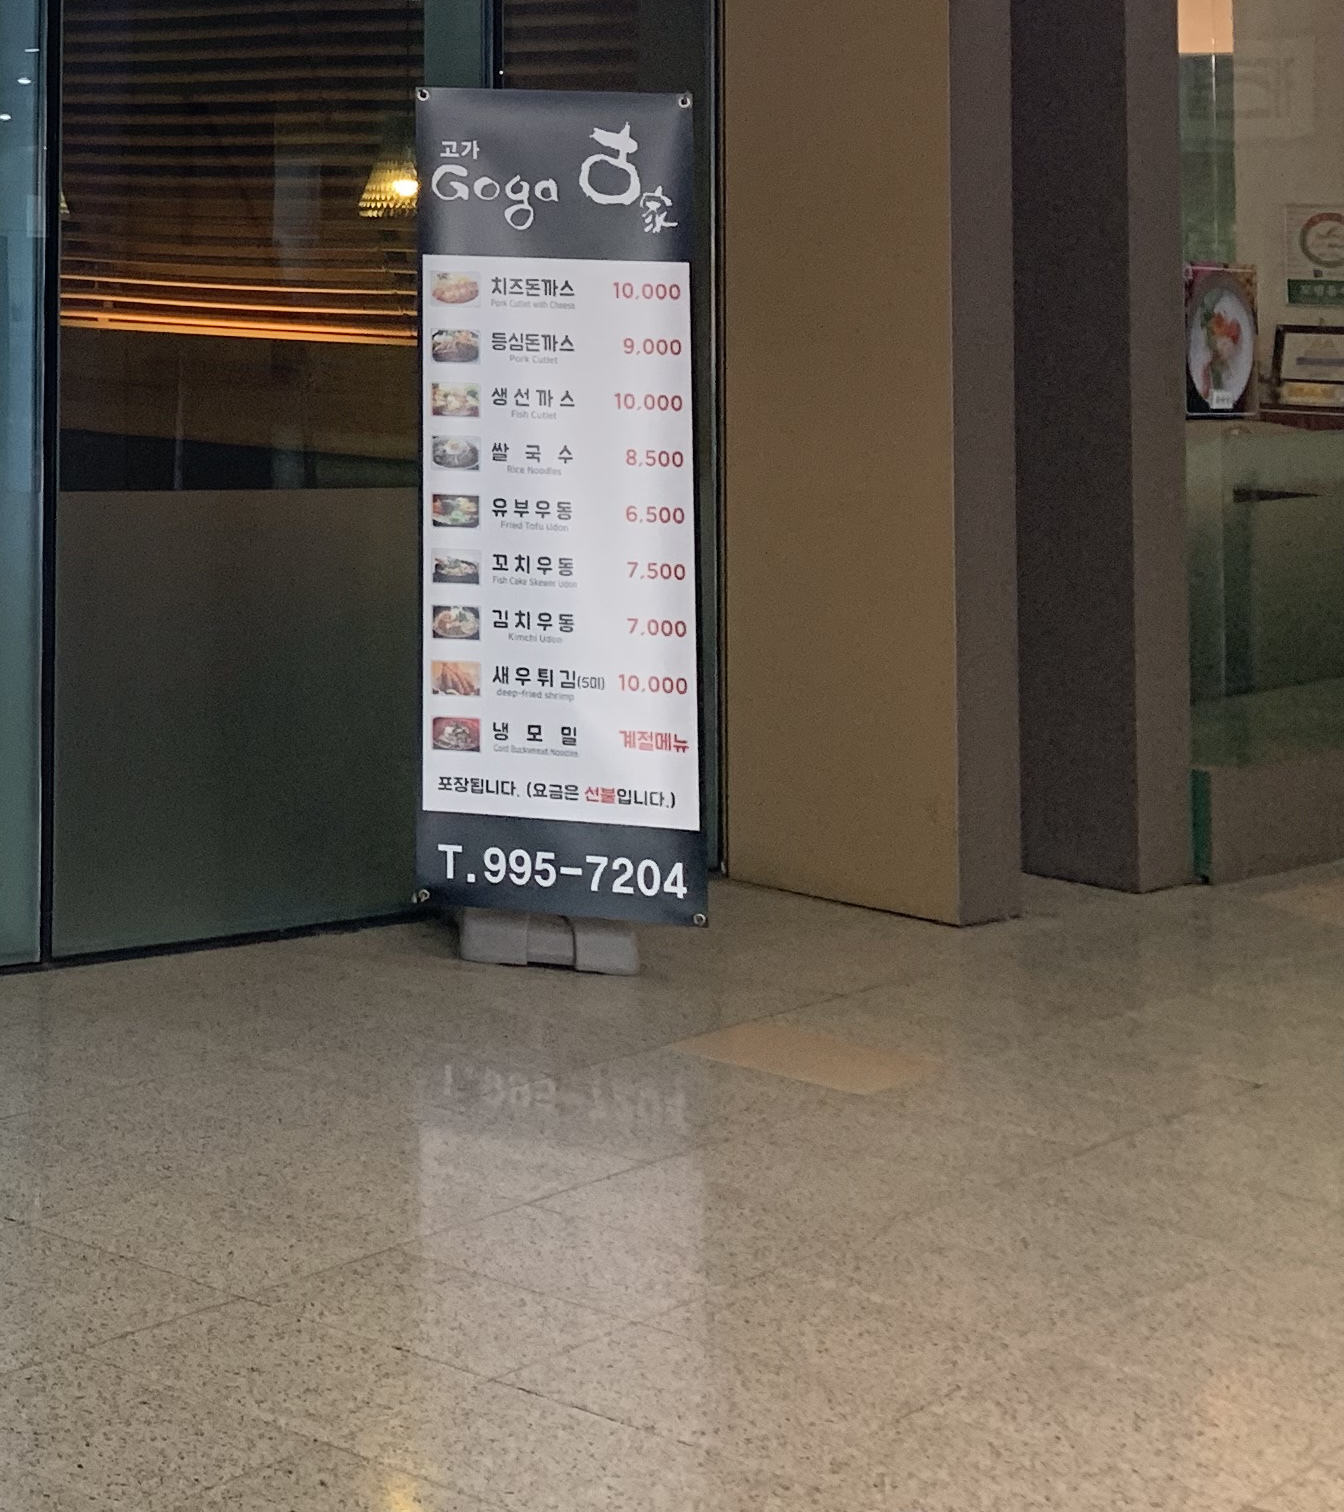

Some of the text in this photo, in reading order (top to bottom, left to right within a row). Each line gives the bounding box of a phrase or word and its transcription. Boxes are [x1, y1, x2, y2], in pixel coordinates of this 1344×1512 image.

[439, 140, 480, 159] 고가
[431, 164, 559, 230] Goga
[491, 276, 681, 301] 치즈돈까스 10,000
[491, 332, 682, 356] 등심돈까스 9,000
[509, 354, 558, 365] Pork Cutlet
[491, 387, 683, 412] 생선까스 10,000
[510, 409, 530, 418] Fish
[491, 442, 684, 468] 쌀국수 8,500
[506, 464, 526, 475] Rice
[491, 497, 573, 521] 유부우동
[491, 553, 574, 577] 꼬치우동
[491, 609, 575, 633] 김치우동
[507, 632, 538, 642] Kimchi
[618, 673, 688, 695] 10,000
[492, 721, 577, 747] 냉모밀
[437, 776, 677, 809] 포장됩니다. (요금은 선불입니다.)
[437, 843, 689, 900] T.995-7204
